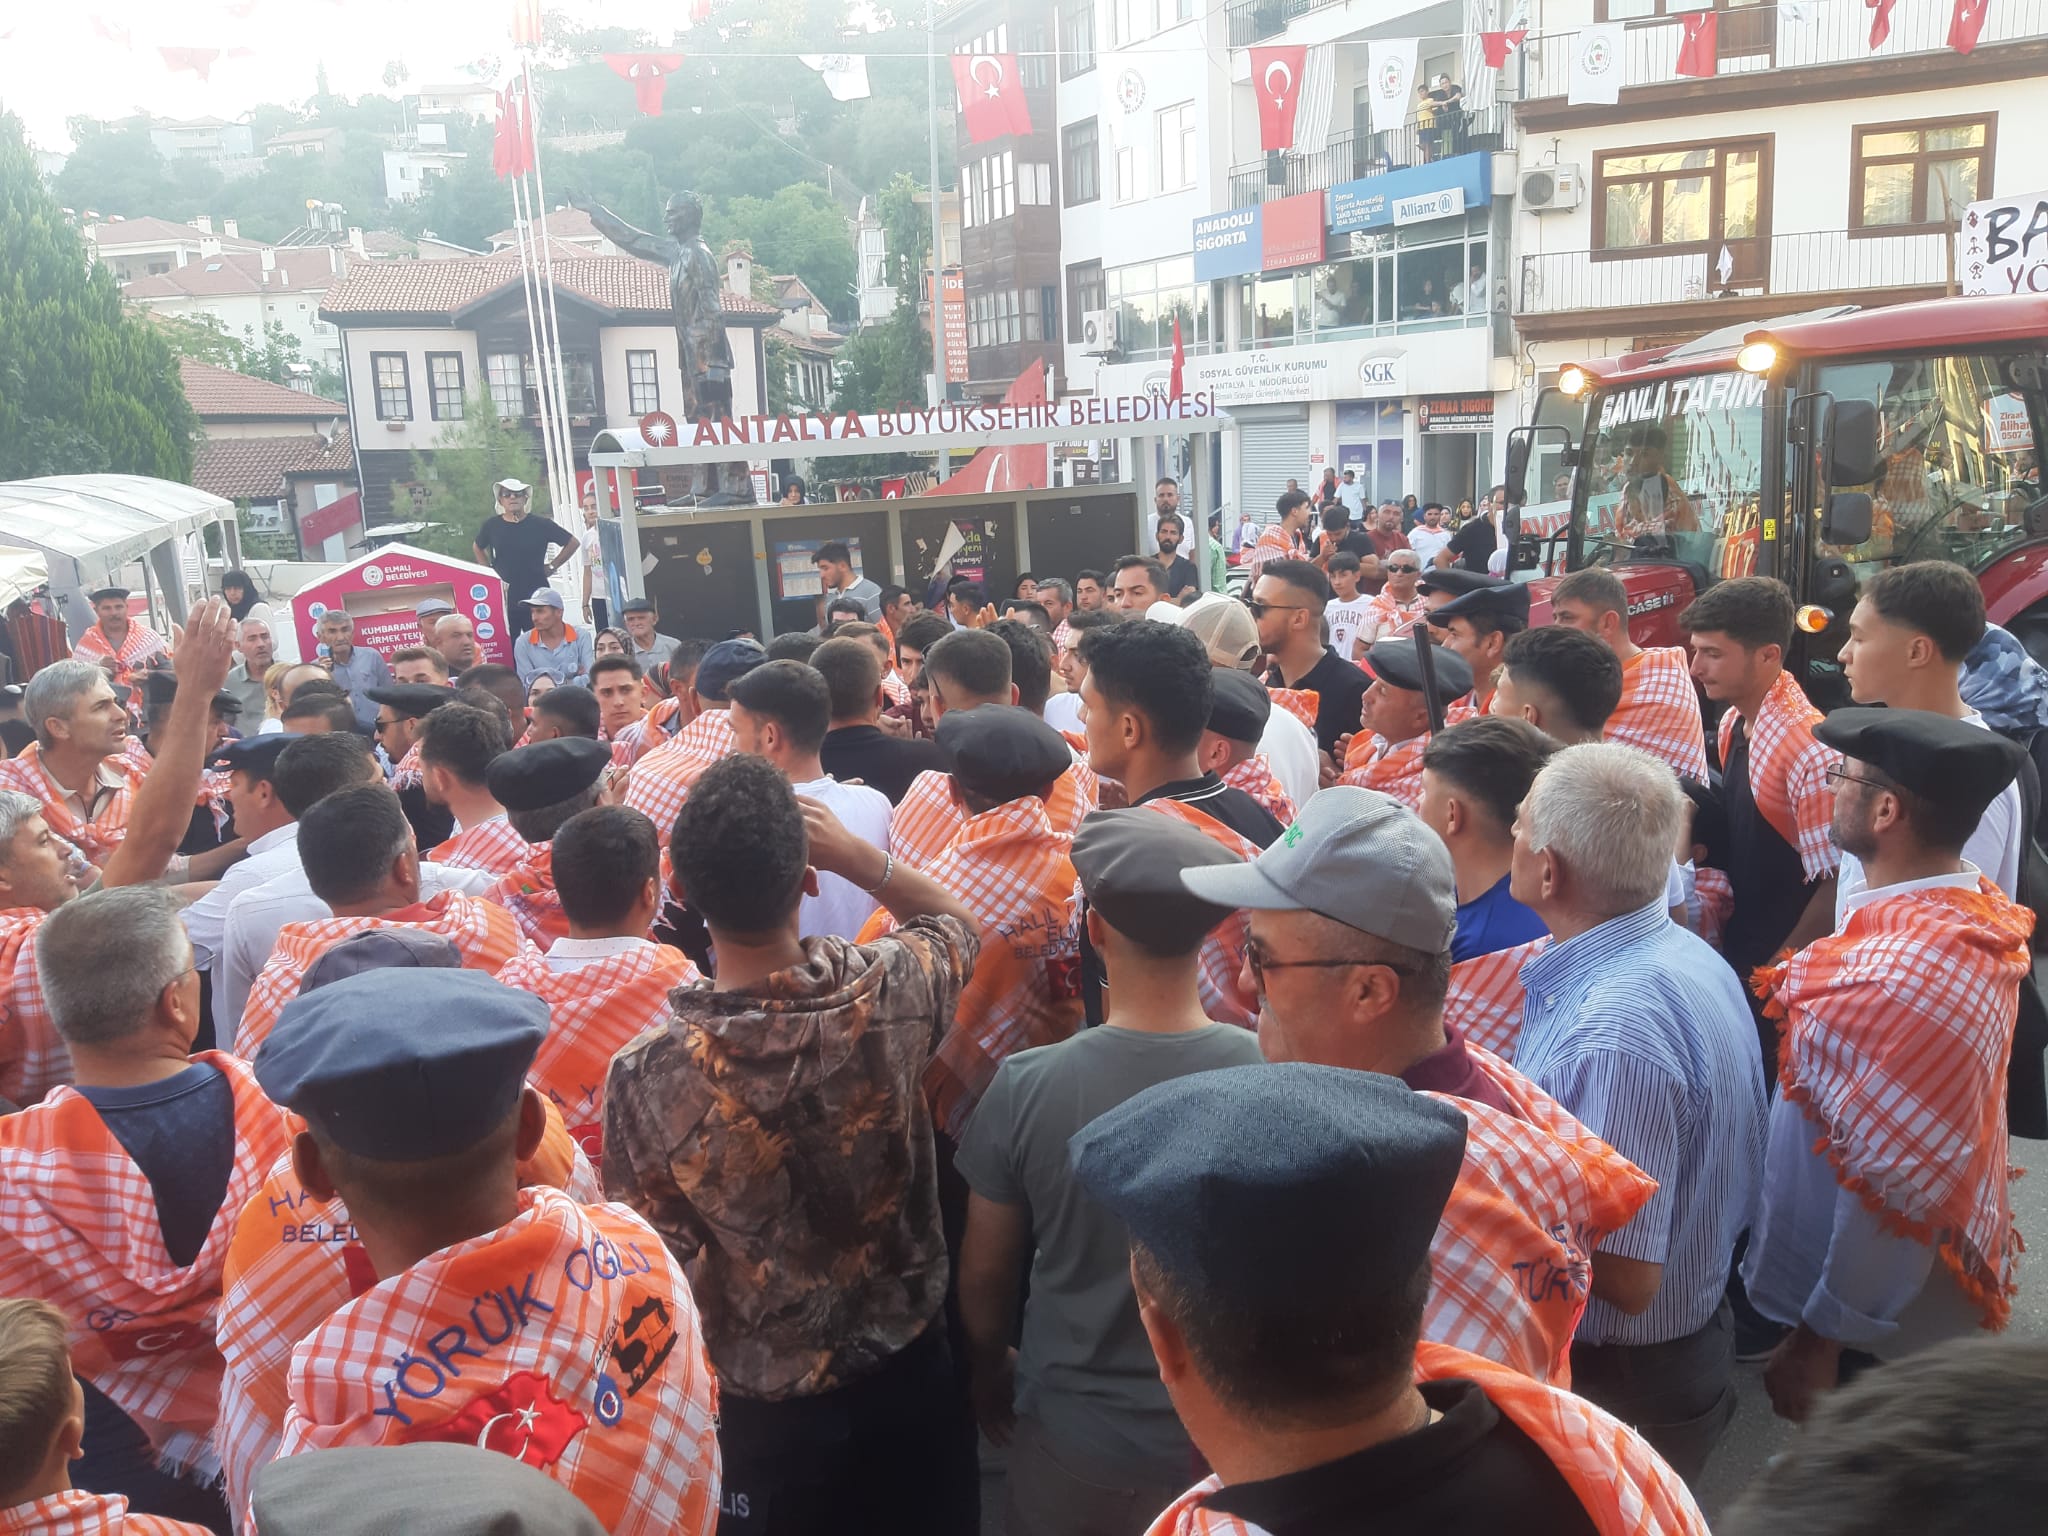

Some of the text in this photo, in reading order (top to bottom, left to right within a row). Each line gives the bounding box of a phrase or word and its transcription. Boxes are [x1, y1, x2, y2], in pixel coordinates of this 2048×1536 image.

[1400, 200, 1436, 219] Allianz
[1195, 211, 1254, 235] ANADOLU
[1195, 230, 1247, 251] SİGORTA
[1250, 354, 1269, 363] T.C.
[1199, 359, 1328, 379] SOSYAL GÜVENLİK KURUMU
[1363, 362, 1396, 383] SGK
[1215, 375, 1310, 390] ANTALYA İL MÜDÜRLÜĞÜ
[1671, 372, 1768, 416] TARIM
[693, 410, 867, 447] ANTALYA
[1070, 384, 1216, 427] BELEDİYESİ
[1999, 411, 2024, 420] Ziraat
[2001, 431, 2022, 440] 0507
[384, 565, 411, 573] ELMALI
[386, 570, 428, 581] BELEDİYESİ
[1627, 597, 1662, 616] CASE
[366, 634, 400, 645] GİRMEK
[379, 645, 392, 653] VE
[374, 1272, 554, 1426] YÖRÜK
[565, 1232, 651, 1292] OĞLU
